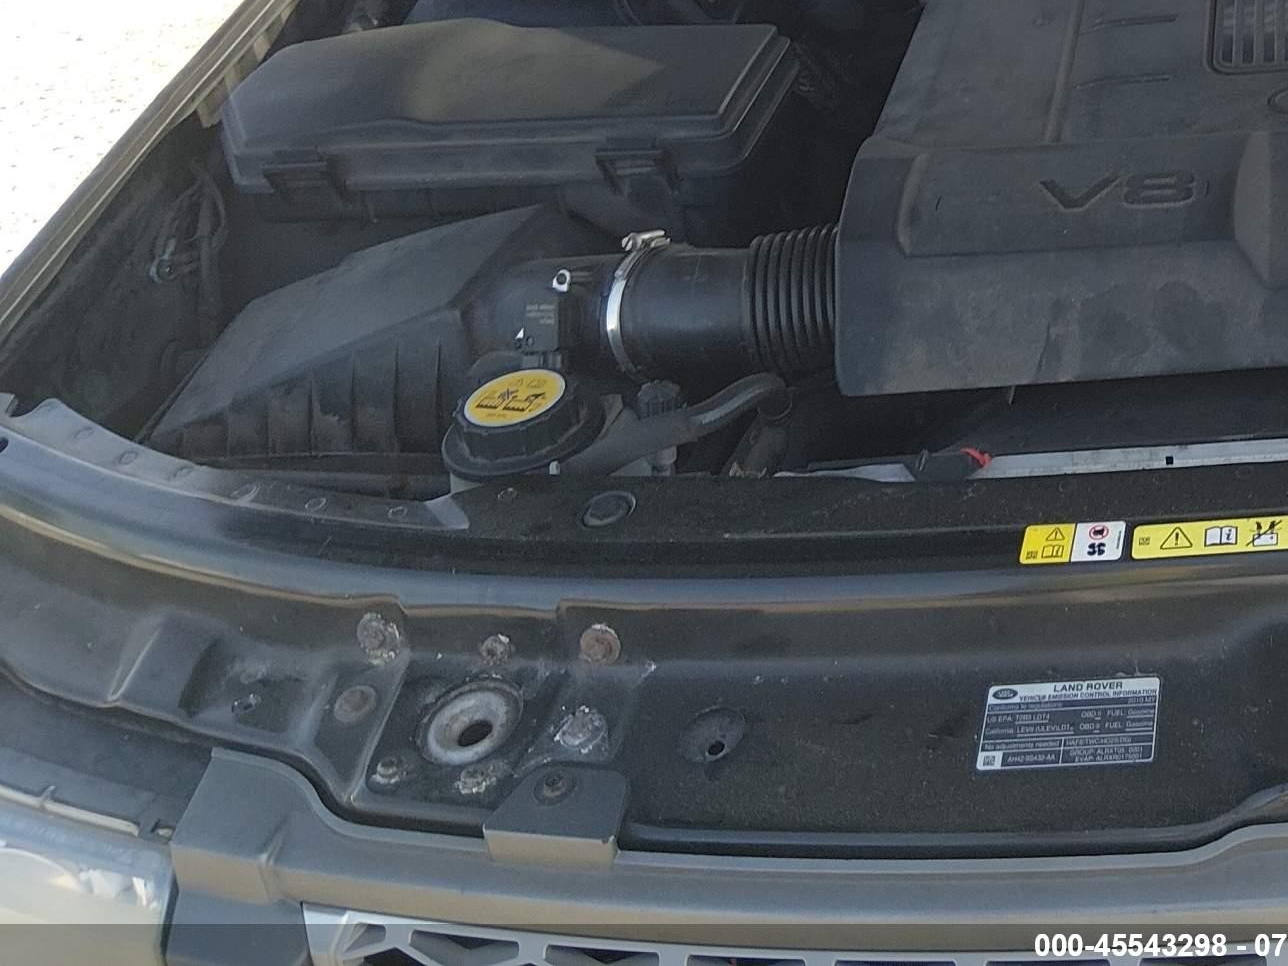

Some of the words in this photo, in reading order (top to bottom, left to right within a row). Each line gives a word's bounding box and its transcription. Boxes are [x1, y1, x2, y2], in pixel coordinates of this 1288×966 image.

[1039, 171, 1198, 211] V8
[1053, 683, 1083, 692] LAND
[1086, 681, 1123, 691] ROVER
[1112, 689, 1157, 697] INFORMATION
